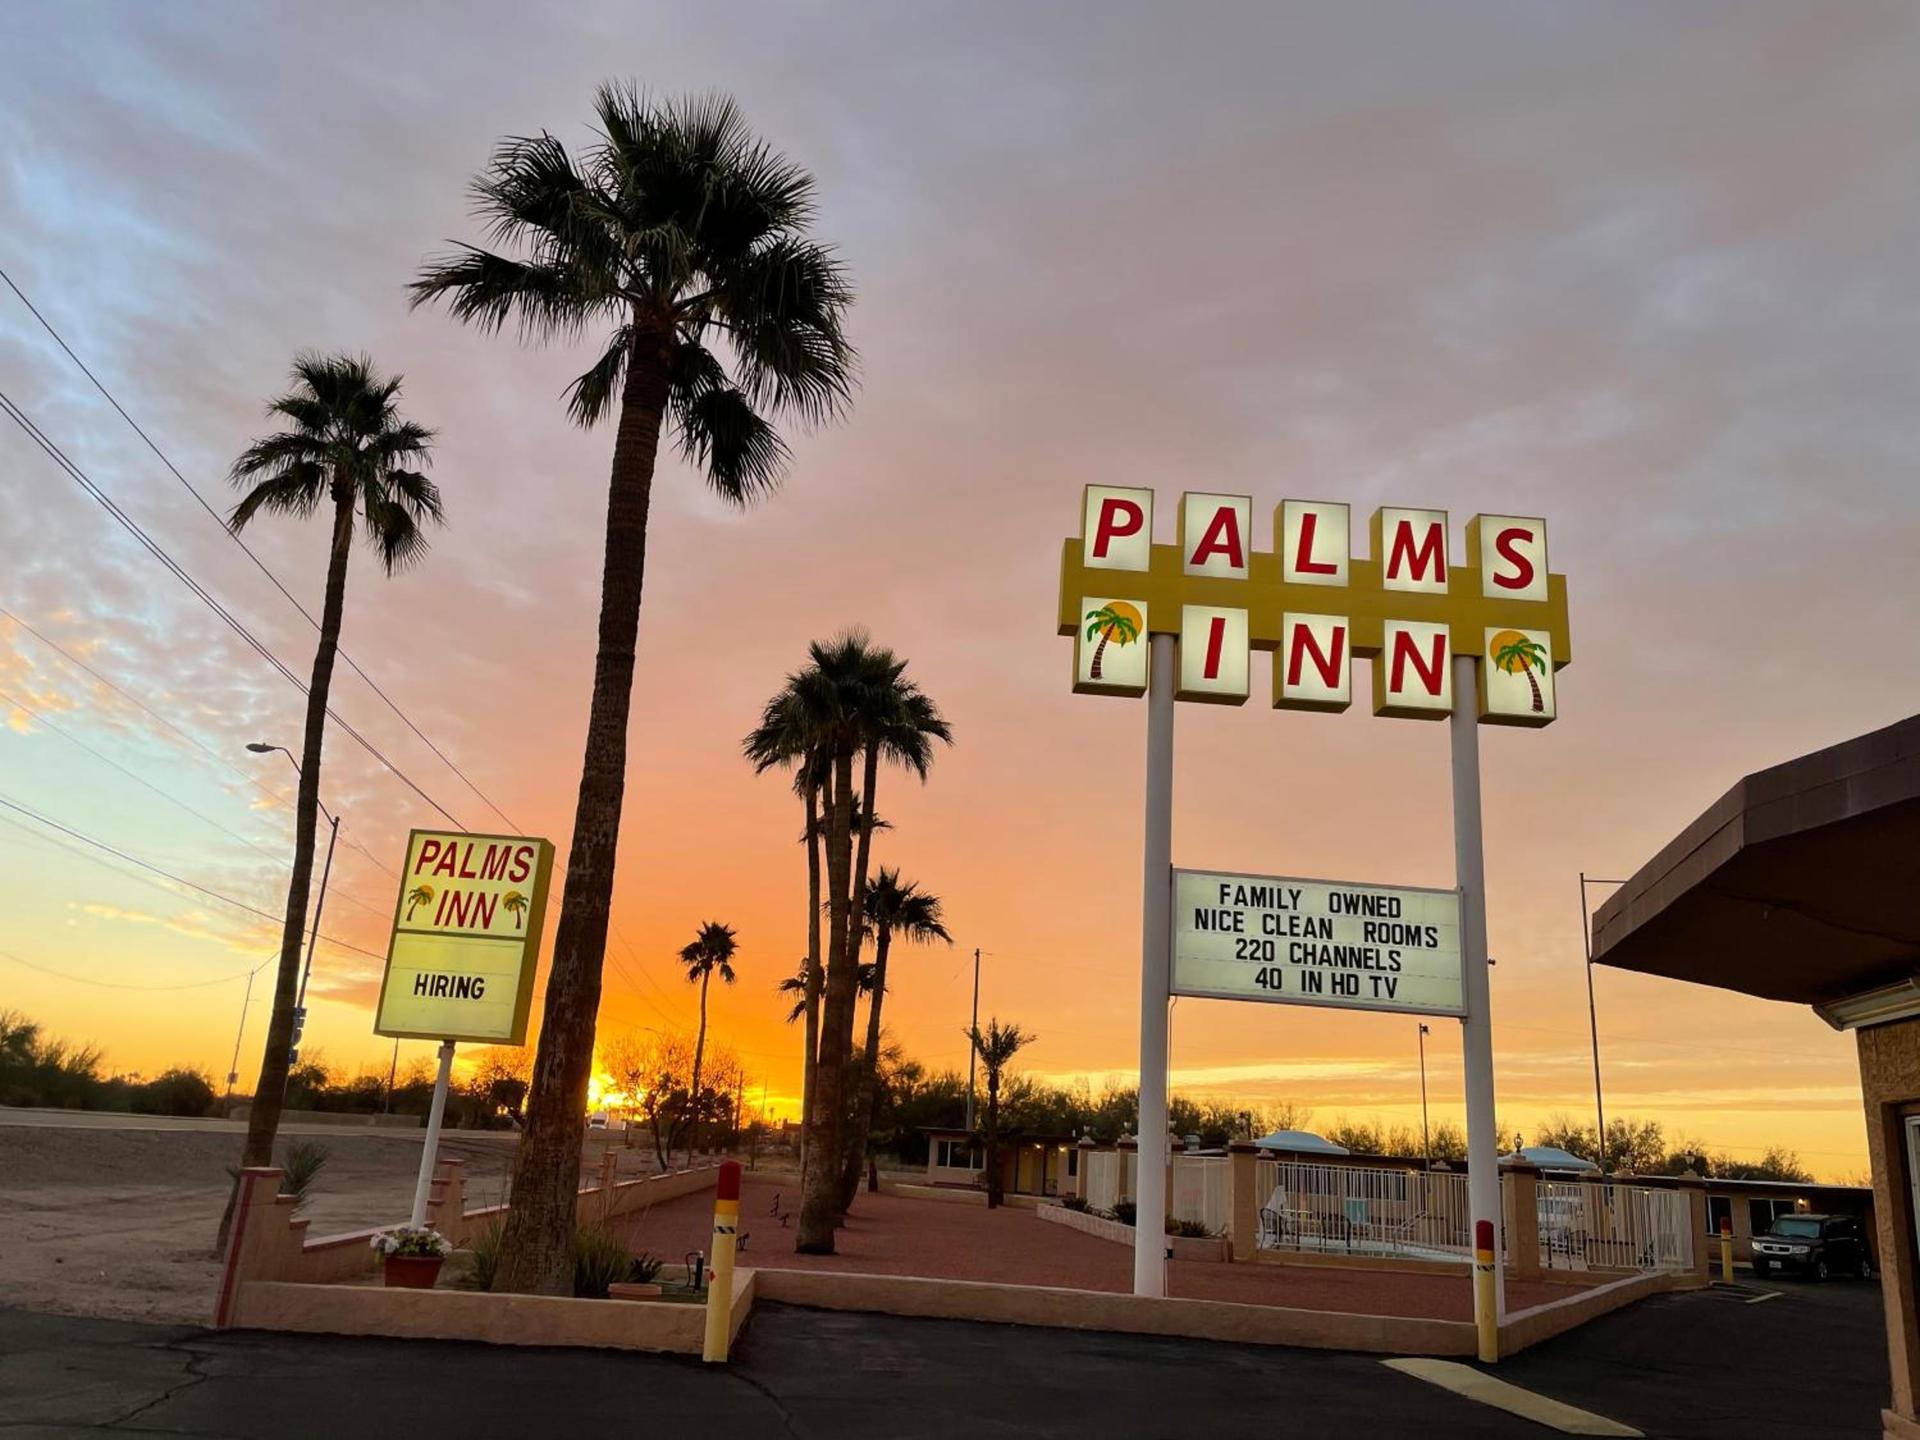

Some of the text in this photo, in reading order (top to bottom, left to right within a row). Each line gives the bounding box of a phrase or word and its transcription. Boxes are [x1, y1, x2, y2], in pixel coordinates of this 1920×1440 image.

[1092, 498, 1535, 590] PALMS
[1203, 617, 1446, 696] INN
[414, 839, 535, 883] PALMS
[433, 889, 499, 930] INN
[1219, 883, 1402, 919] FAMILY OWNED
[1194, 908, 1439, 949] NICE CLEAN ROOMS
[1235, 938, 1401, 973] 220 CHANNELS
[413, 973, 485, 1000] HIRING
[1255, 967, 1398, 999] 40 IN HD TV
